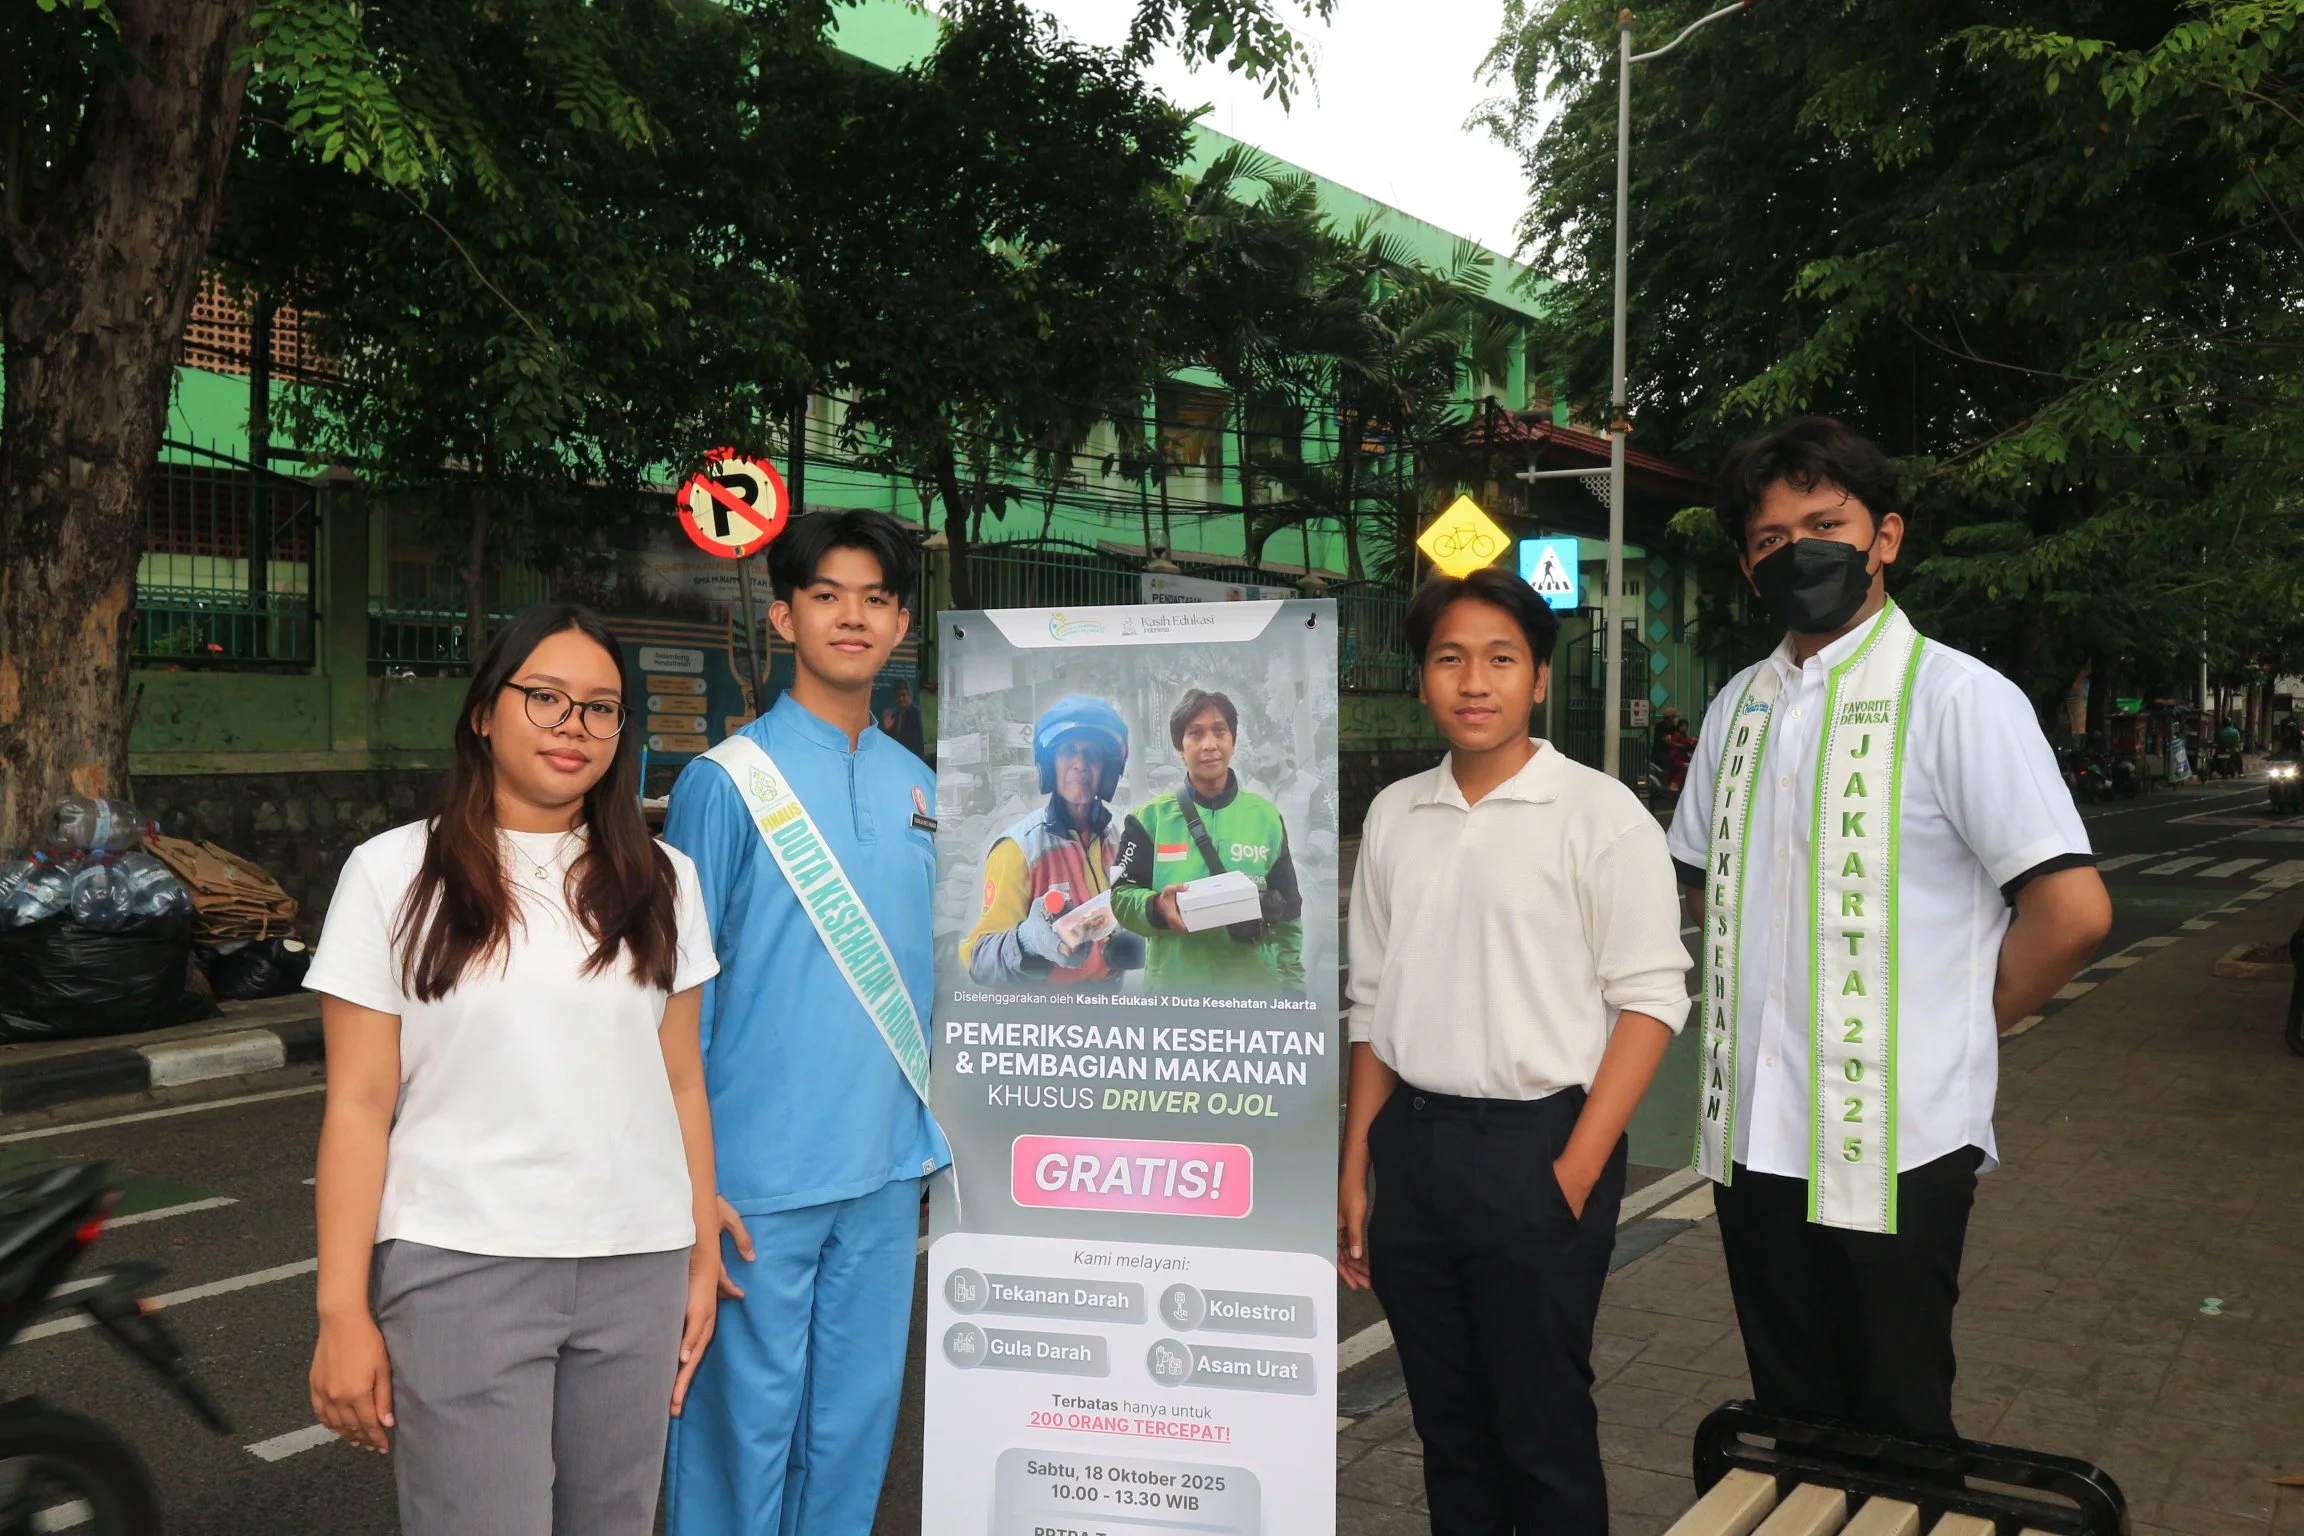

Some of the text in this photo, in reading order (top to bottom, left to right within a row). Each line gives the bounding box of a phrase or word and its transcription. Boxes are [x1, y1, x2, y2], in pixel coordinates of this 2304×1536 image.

[711, 575, 768, 588] MUHAMMIYAH
[1141, 614, 1215, 627] Kasih Edukasi
[1840, 712, 1889, 725] DEWASA
[1843, 700, 1892, 714] FAVORITE
[760, 801, 803, 834] FINALIS
[771, 819, 835, 889] DUTA
[806, 877, 896, 1006] KESEHATAN
[1842, 733, 1871, 1163] JAKARTA 2025
[953, 991, 1317, 1011] Diselenggarakan oleh Kasih Edukasi X Duta Kesehatan Jakarta
[945, 1022, 1326, 1056] PEMERIKSAAN KESEHATAN
[955, 1051, 1308, 1086] & PEMBAGIAN MAKANAN
[988, 1084, 1280, 1117] KHUSUS DRIVER OJOL
[1035, 1153, 1226, 1200] GRATIS!
[1073, 1250, 1191, 1272] Kami melayani:
[992, 1284, 1129, 1309] Tekanan Darah
[1210, 1300, 1296, 1322] Kolestrol
[990, 1339, 1092, 1362] Gula Darah
[1197, 1356, 1299, 1379] Asam Urat
[1052, 1394, 1212, 1419] Terbatas hanya untuk
[1030, 1411, 1231, 1442] 200 ORANG TERCEPAT!
[1027, 1461, 1226, 1492] Sabtu, 18 Oktober 2025
[1052, 1484, 1099, 1501] 10.00
[1115, 1490, 1161, 1507] 13.30
[1166, 1494, 1199, 1511] WIB
